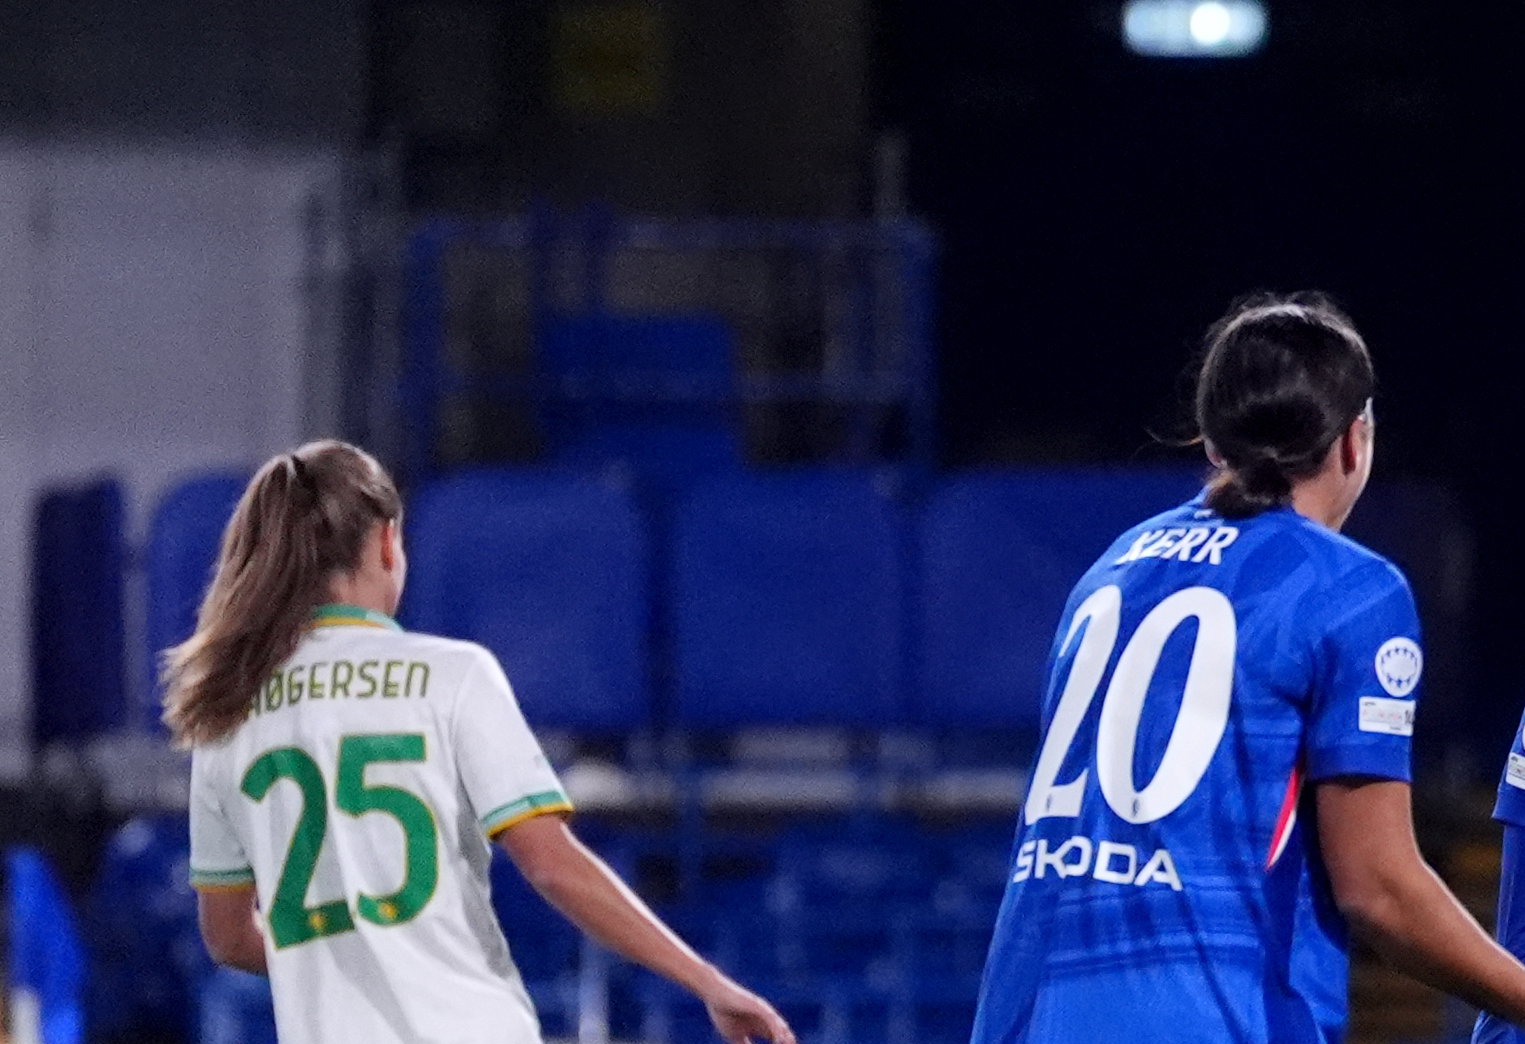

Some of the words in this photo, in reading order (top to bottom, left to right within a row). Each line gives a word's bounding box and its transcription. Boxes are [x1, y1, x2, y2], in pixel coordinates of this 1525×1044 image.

[1114, 526, 1239, 565] KERR
[1025, 585, 1237, 825] 20
[241, 733, 438, 951] 25
[1013, 835, 1183, 891] SKODA
